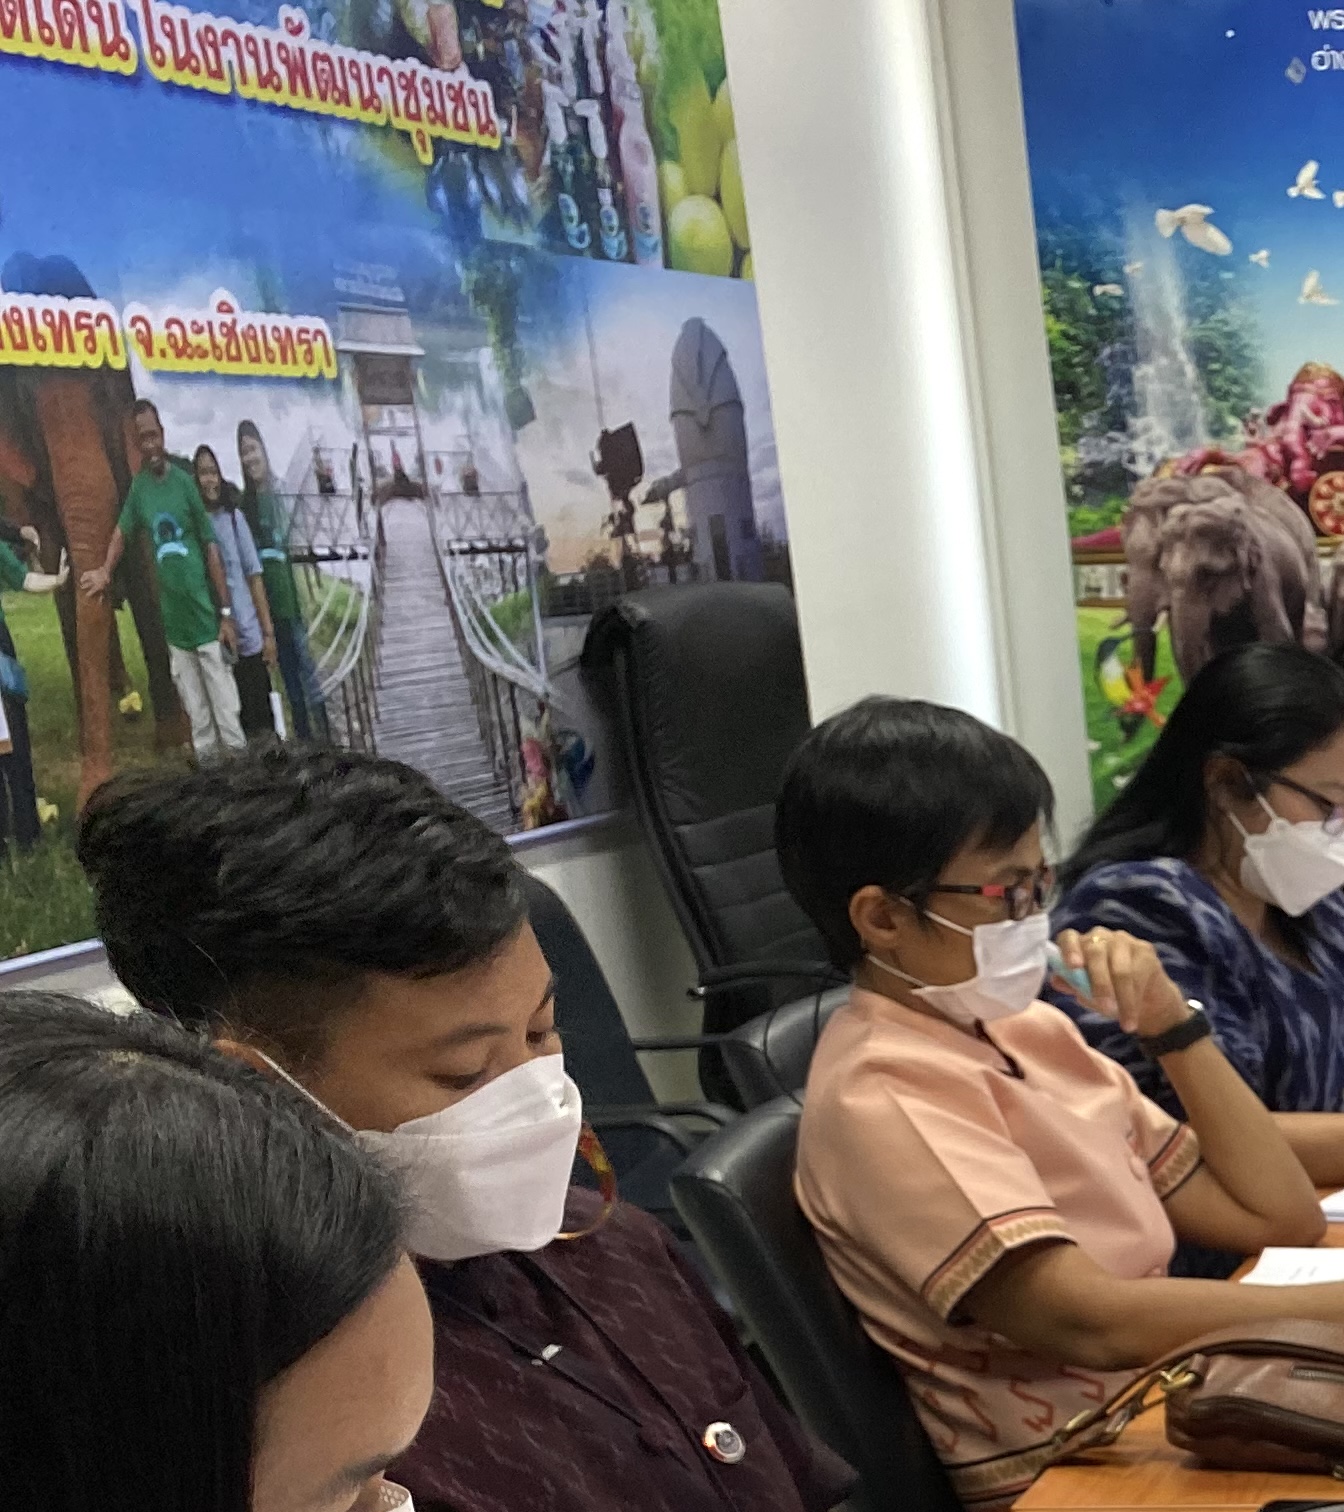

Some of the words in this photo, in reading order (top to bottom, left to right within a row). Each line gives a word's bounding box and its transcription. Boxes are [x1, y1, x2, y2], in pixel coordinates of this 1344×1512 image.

[0, 305, 118, 357] งเทรา
[129, 300, 333, 369] จ.ฉะเชิงเทรา
